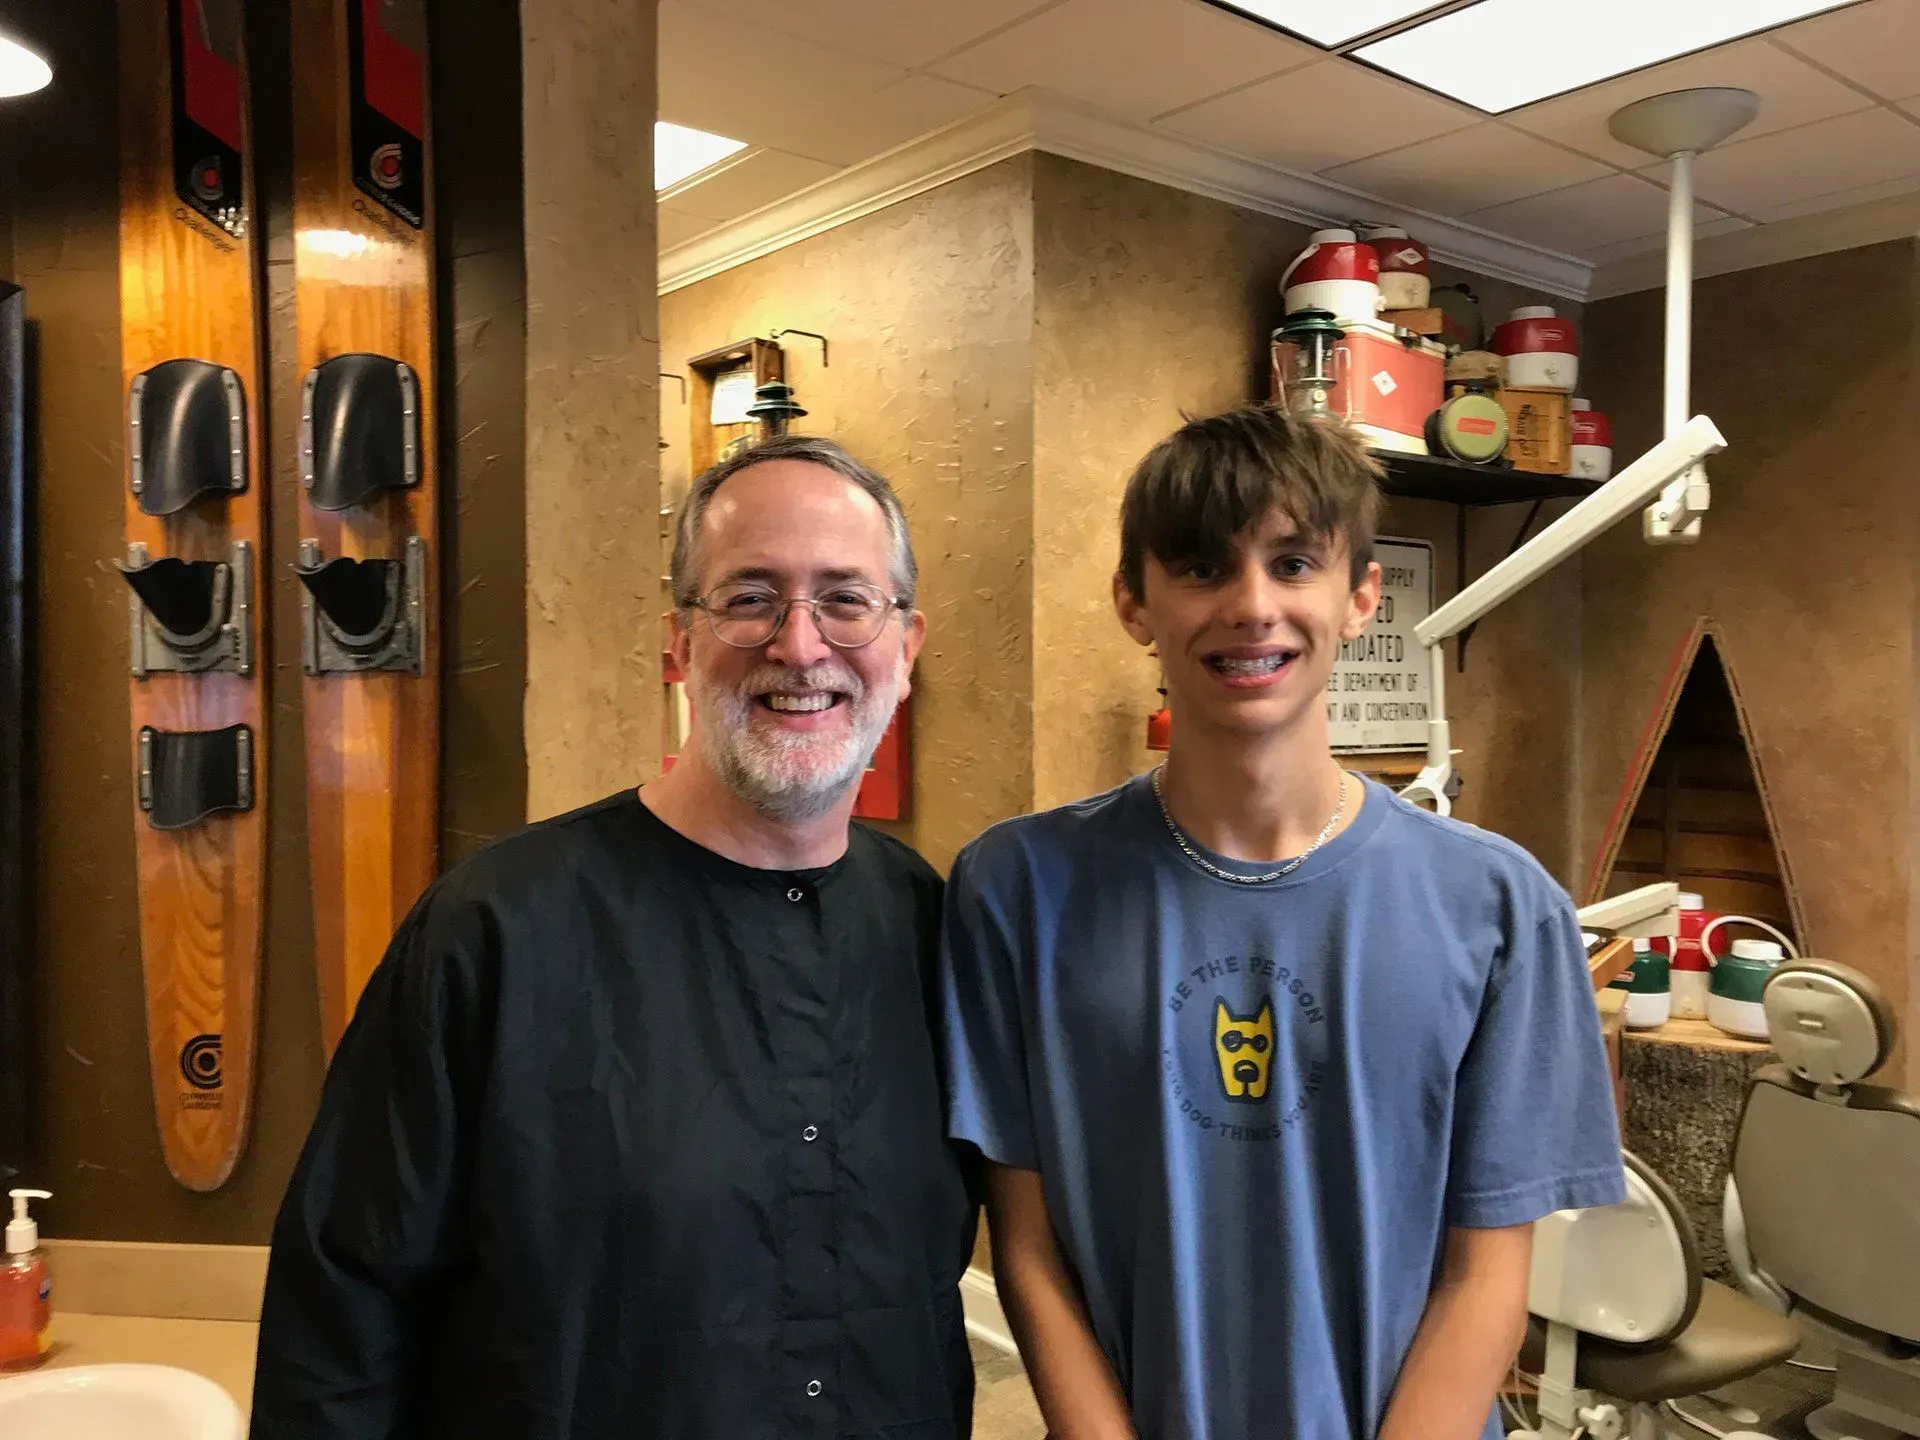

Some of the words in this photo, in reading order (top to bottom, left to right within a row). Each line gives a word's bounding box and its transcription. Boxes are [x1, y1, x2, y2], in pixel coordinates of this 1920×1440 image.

[1344, 673, 1401, 691] DEPARTMENT
[1407, 673, 1418, 692] OF
[1342, 703, 1360, 721] AND
[1365, 702, 1428, 721] CONSERVATION
[1169, 981, 1193, 1013] BE
[1190, 955, 1240, 984] THE
[1250, 956, 1325, 1025] PERSON
[1180, 1099, 1213, 1130] DOG
